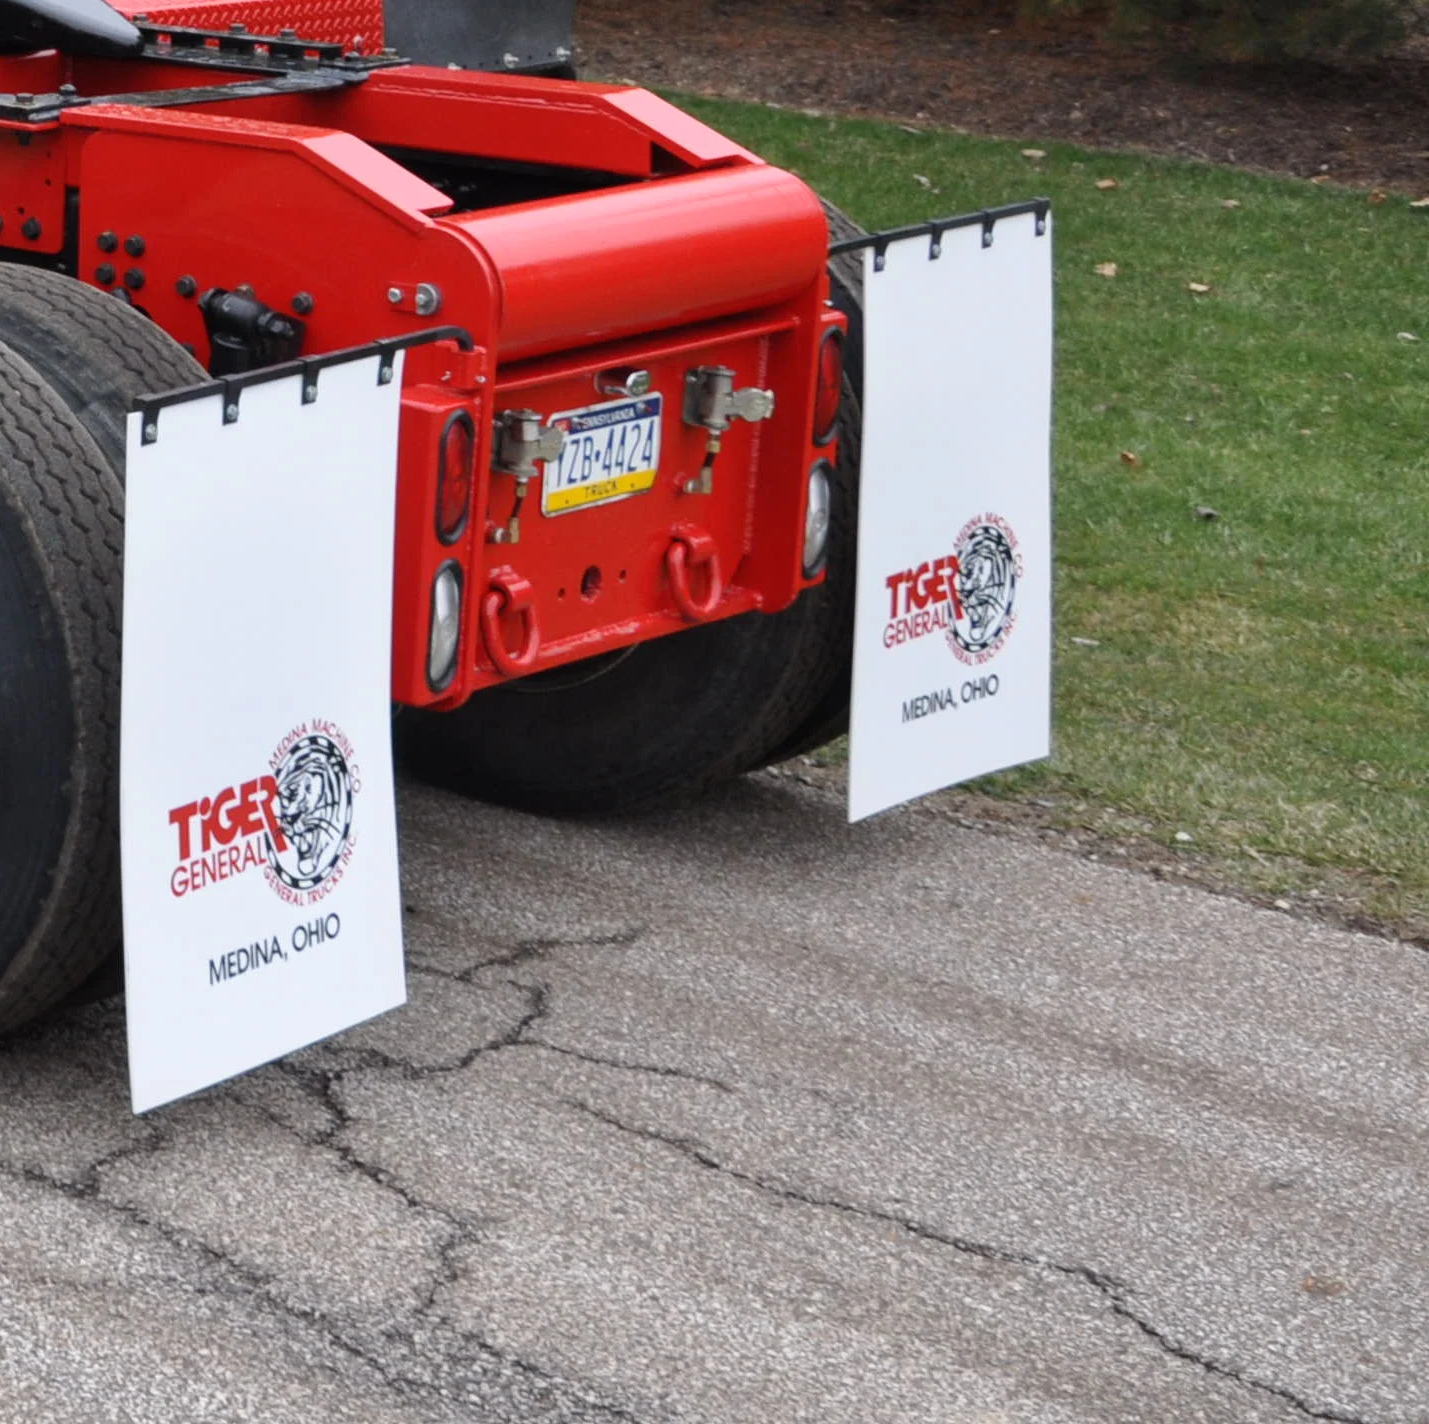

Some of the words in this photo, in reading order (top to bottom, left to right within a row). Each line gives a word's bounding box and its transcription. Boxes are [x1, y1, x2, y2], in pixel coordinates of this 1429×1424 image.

[584, 480, 618, 498] TRUCK
[883, 603, 949, 648] GENERAL
[901, 687, 958, 723] MEDINA,
[960, 674, 999, 704] OHIO
[268, 722, 308, 770] MEDINA
[312, 717, 354, 761] MACHINE
[170, 835, 267, 898] GENERAL
[264, 865, 305, 907] GENERAL
[307, 867, 344, 905] TRUCKS
[208, 935, 288, 986] MEDINA,
[291, 912, 341, 953] OHIO
